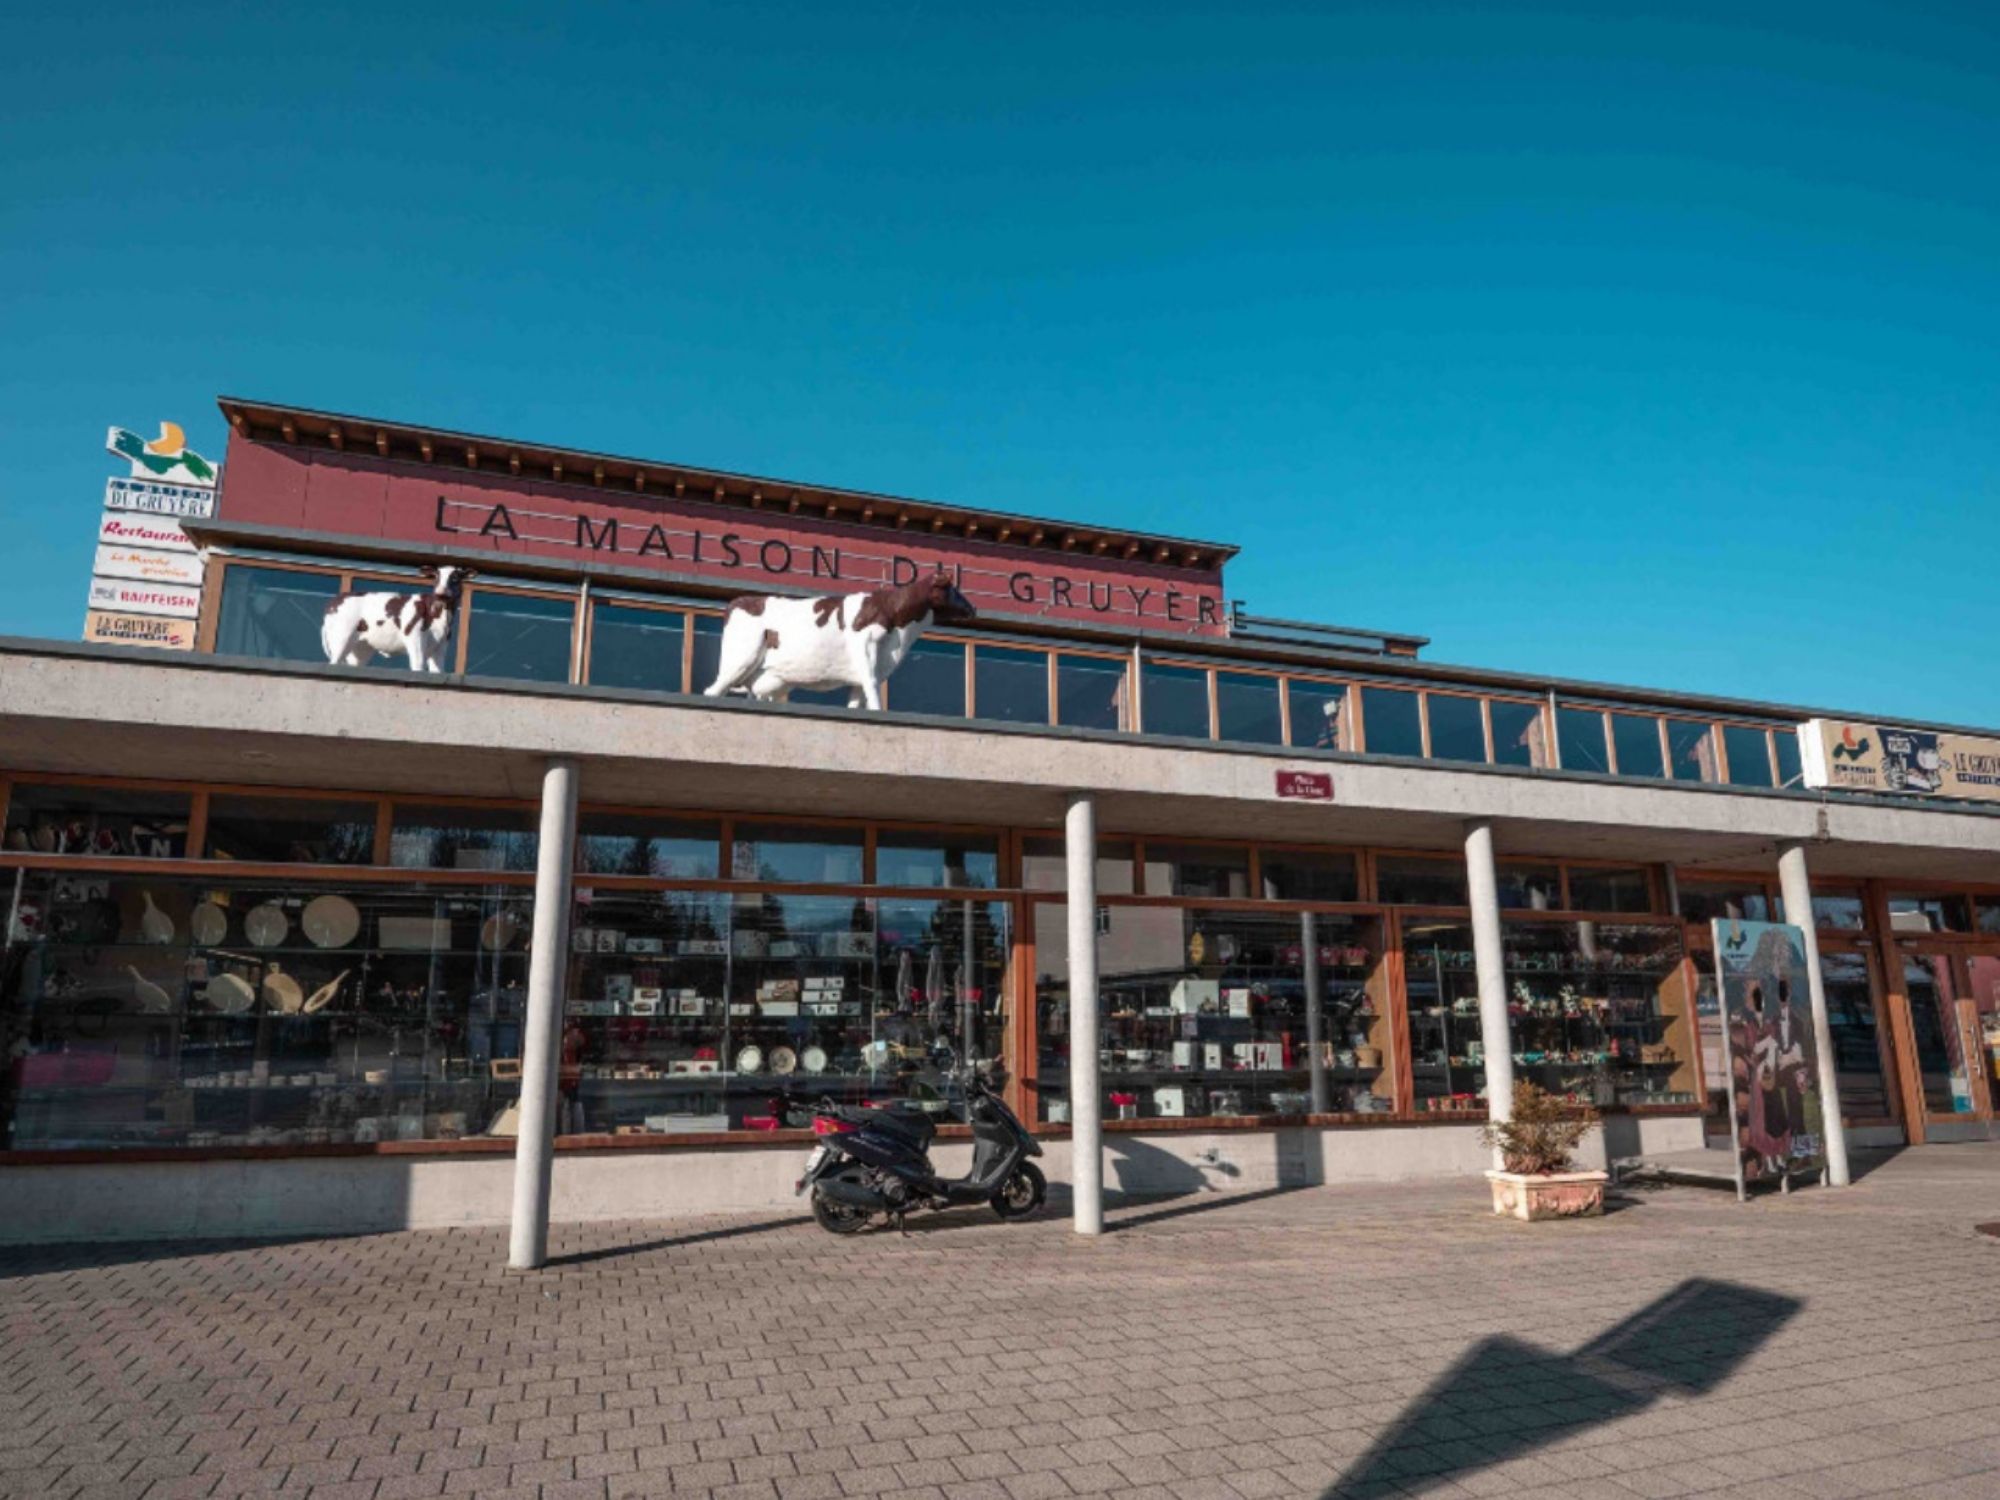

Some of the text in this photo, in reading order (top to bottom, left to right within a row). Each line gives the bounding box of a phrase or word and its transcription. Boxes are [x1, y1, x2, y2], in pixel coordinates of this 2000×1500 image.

[436, 496, 518, 541] LA
[576, 514, 841, 580] MAISON
[1008, 571, 1248, 631] GRUYÈRE
